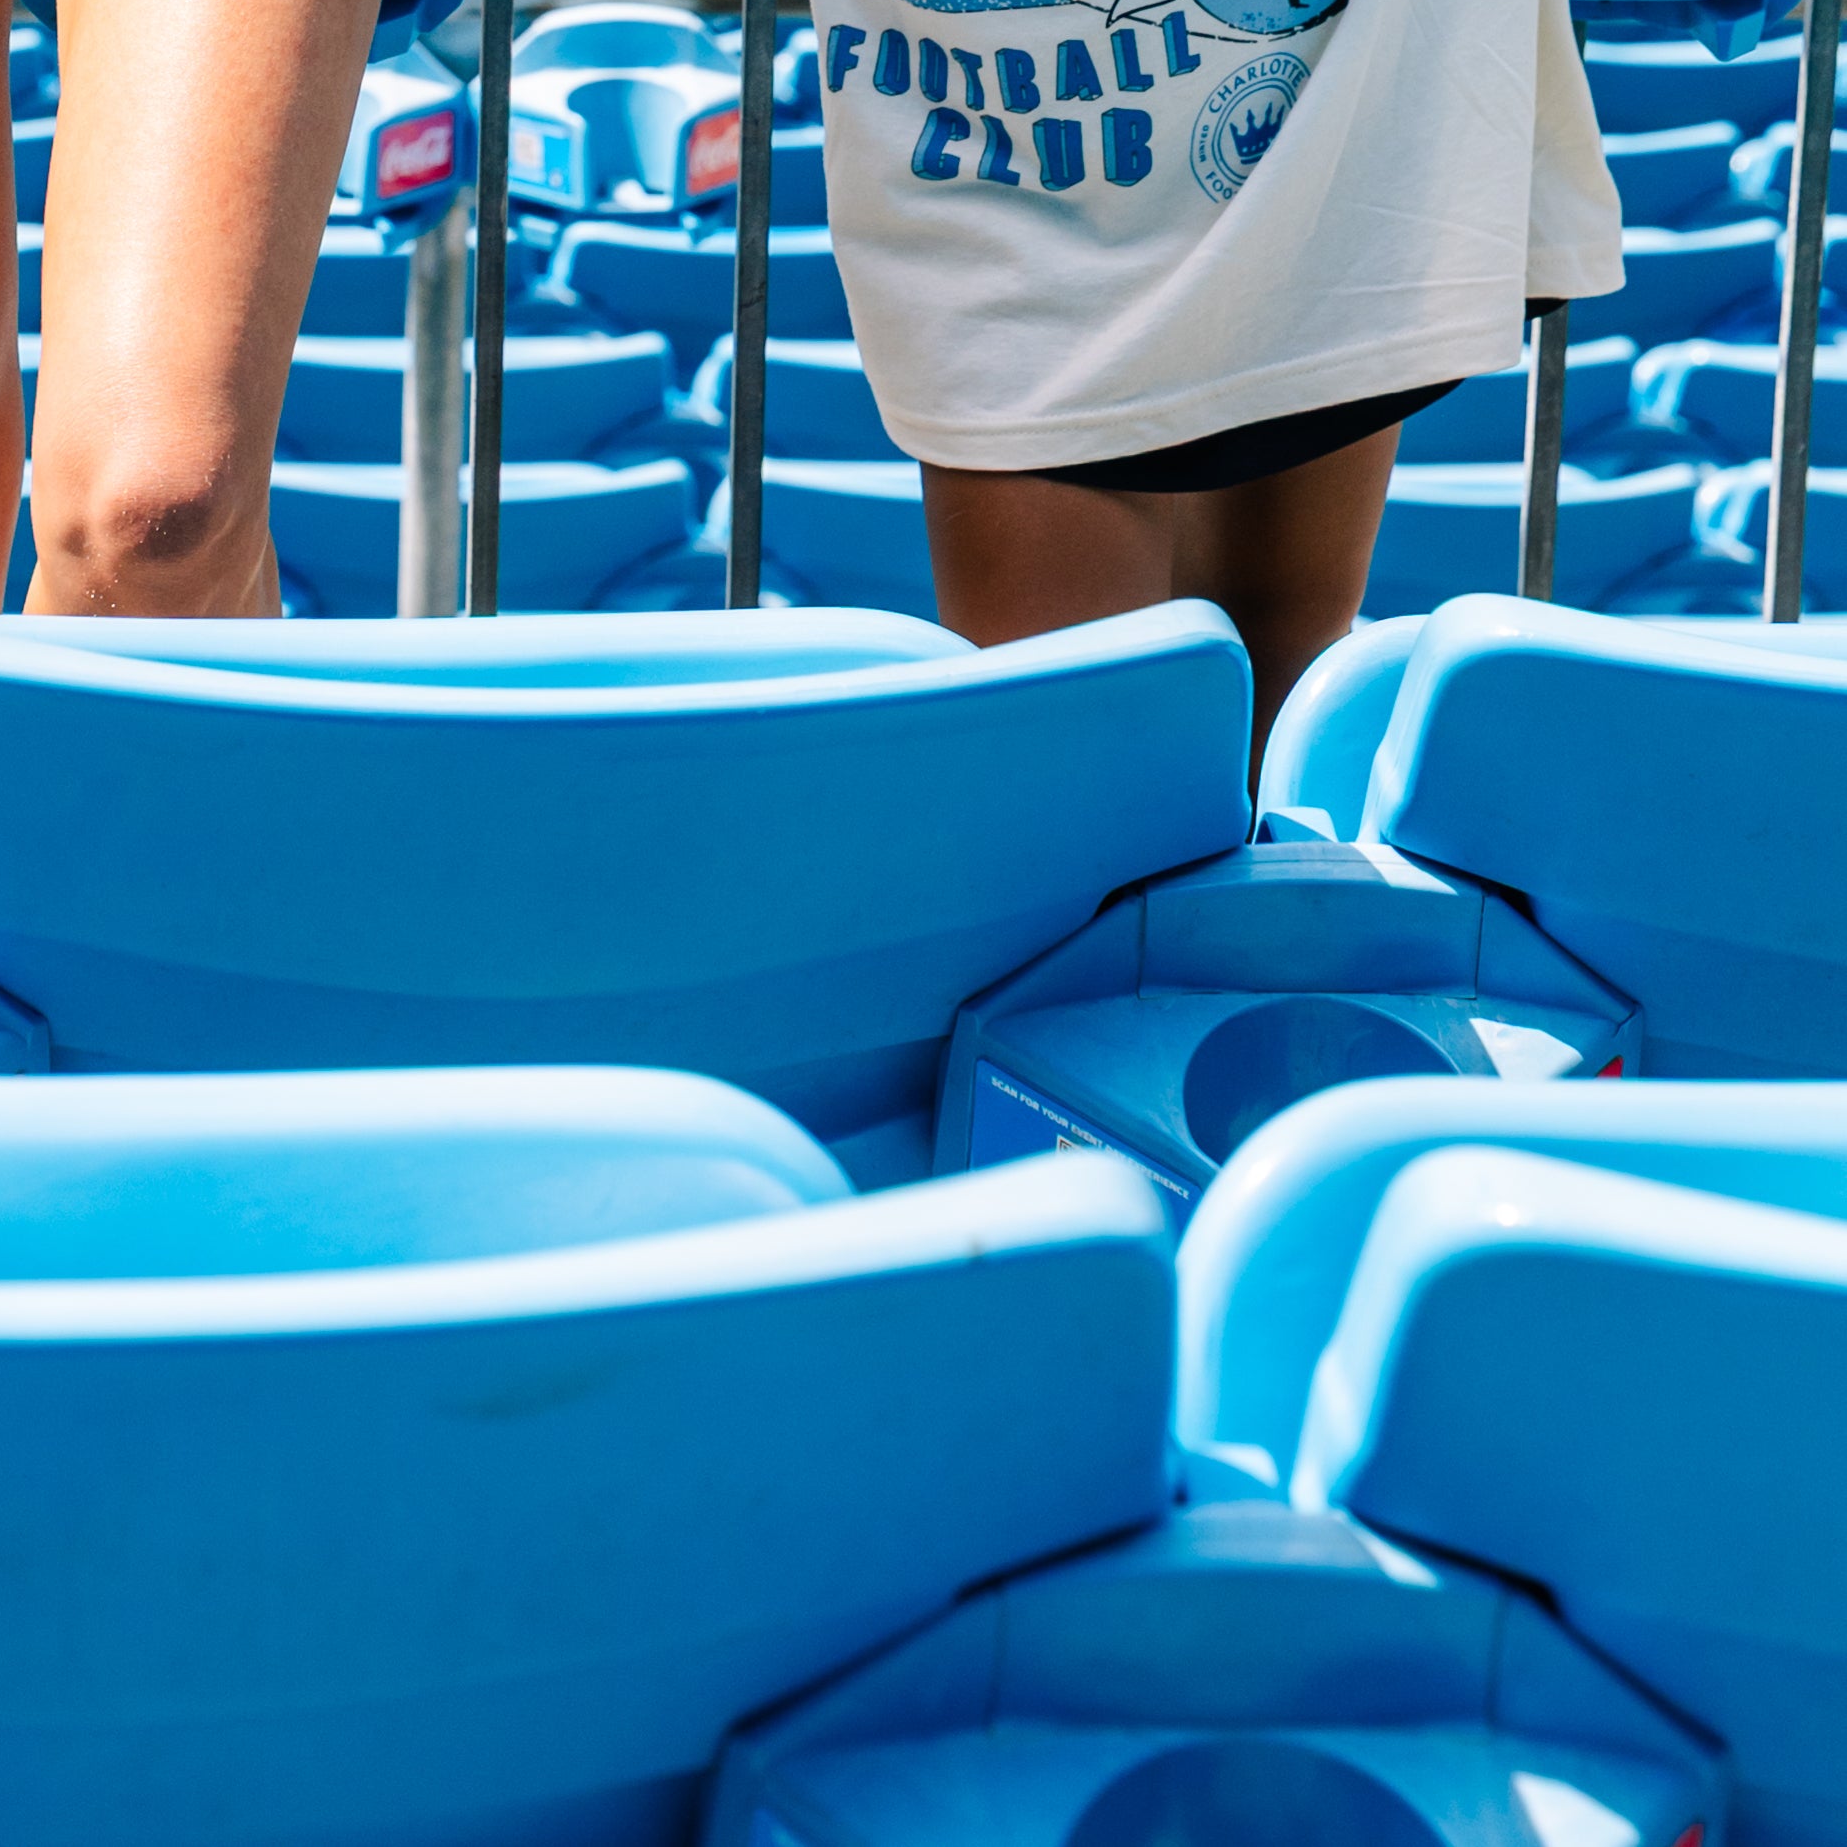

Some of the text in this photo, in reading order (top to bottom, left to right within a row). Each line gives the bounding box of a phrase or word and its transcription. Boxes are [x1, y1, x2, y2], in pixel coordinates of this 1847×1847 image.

[826, 11, 1201, 114] FOOTBALL
[1209, 58, 1306, 113] CHARLOTTE
[911, 107, 1153, 192] CLUB
[991, 1076, 1018, 1099] SCAN
[1020, 1093, 1040, 1112] FOR
[1042, 1106, 1069, 1129] YOUR
[1071, 1123, 1104, 1150] EVENT
